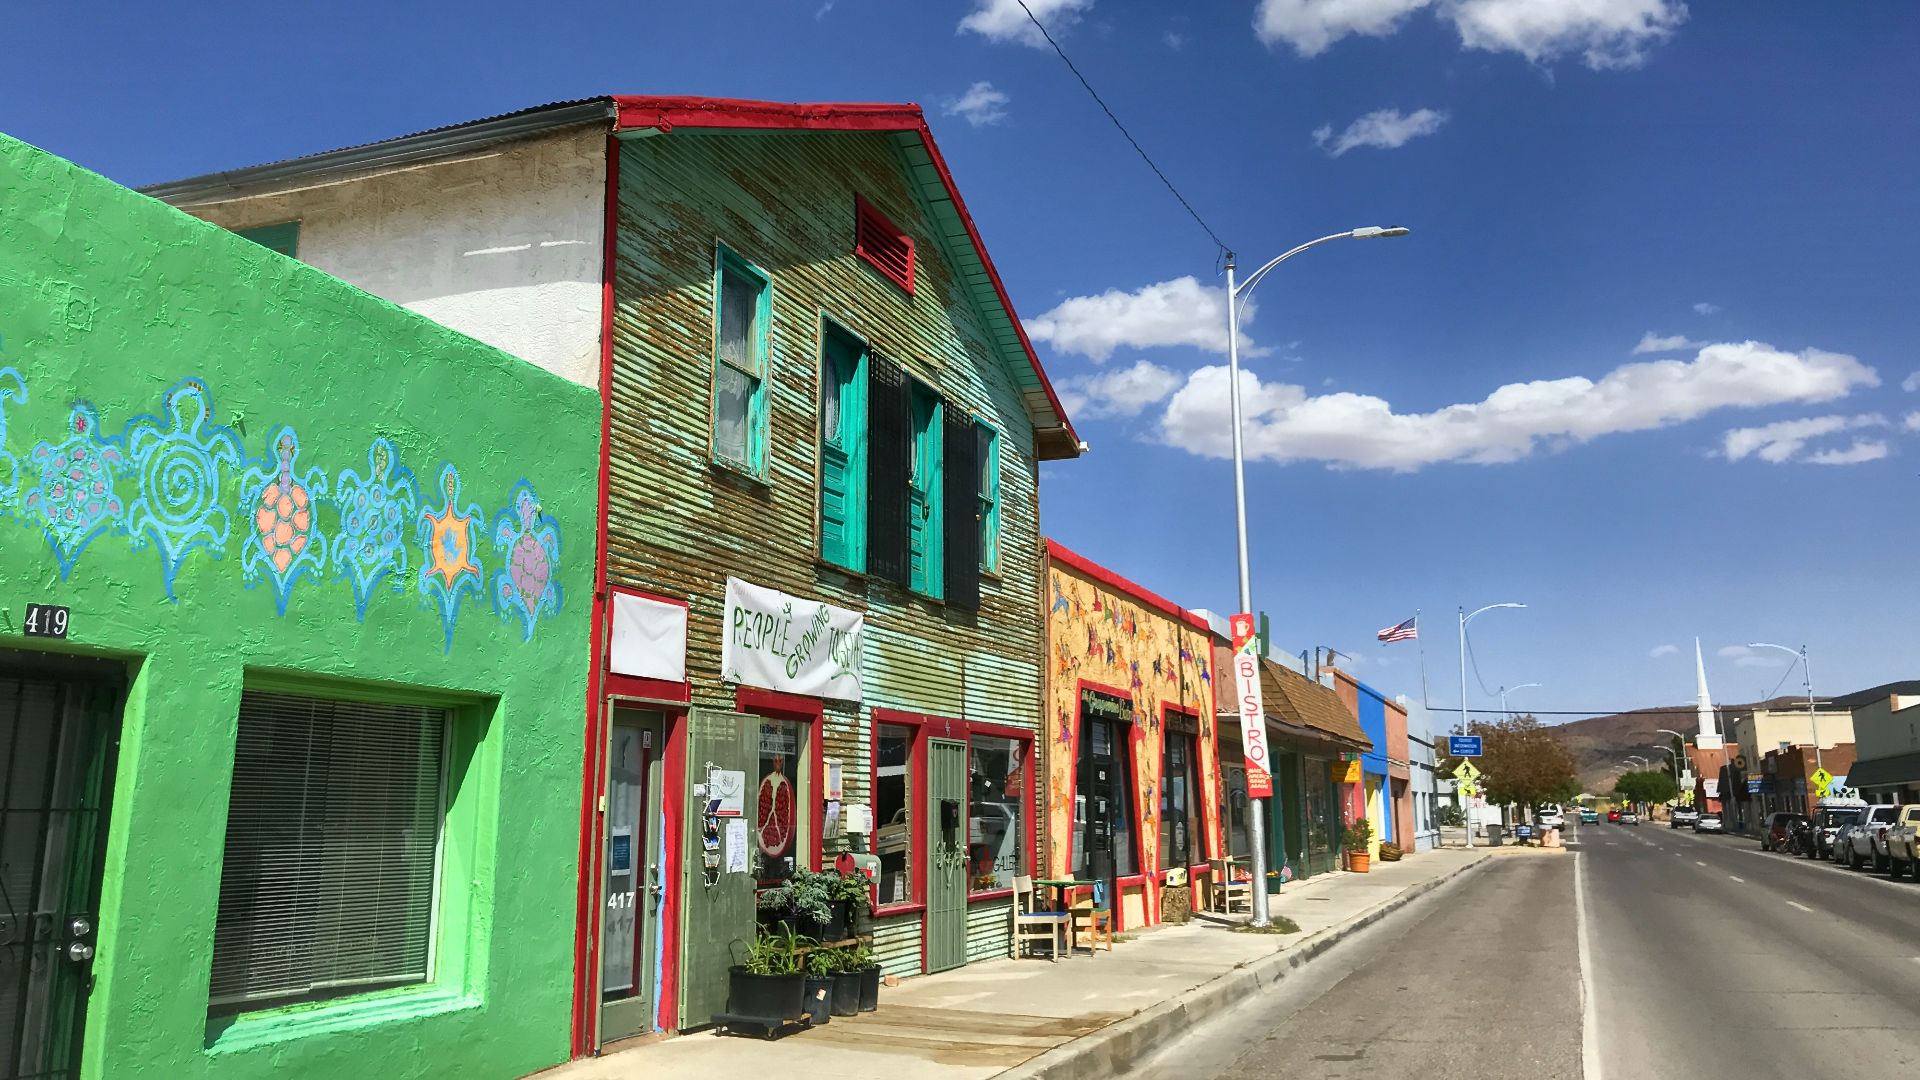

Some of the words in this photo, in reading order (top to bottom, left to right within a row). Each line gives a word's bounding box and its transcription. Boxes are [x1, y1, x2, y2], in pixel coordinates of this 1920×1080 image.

[25, 607, 68, 635] 419
[733, 606, 792, 658] PEOPLE
[785, 603, 831, 680] GROWING
[1240, 661, 1265, 761] BISTRO
[607, 891, 635, 910] 417
